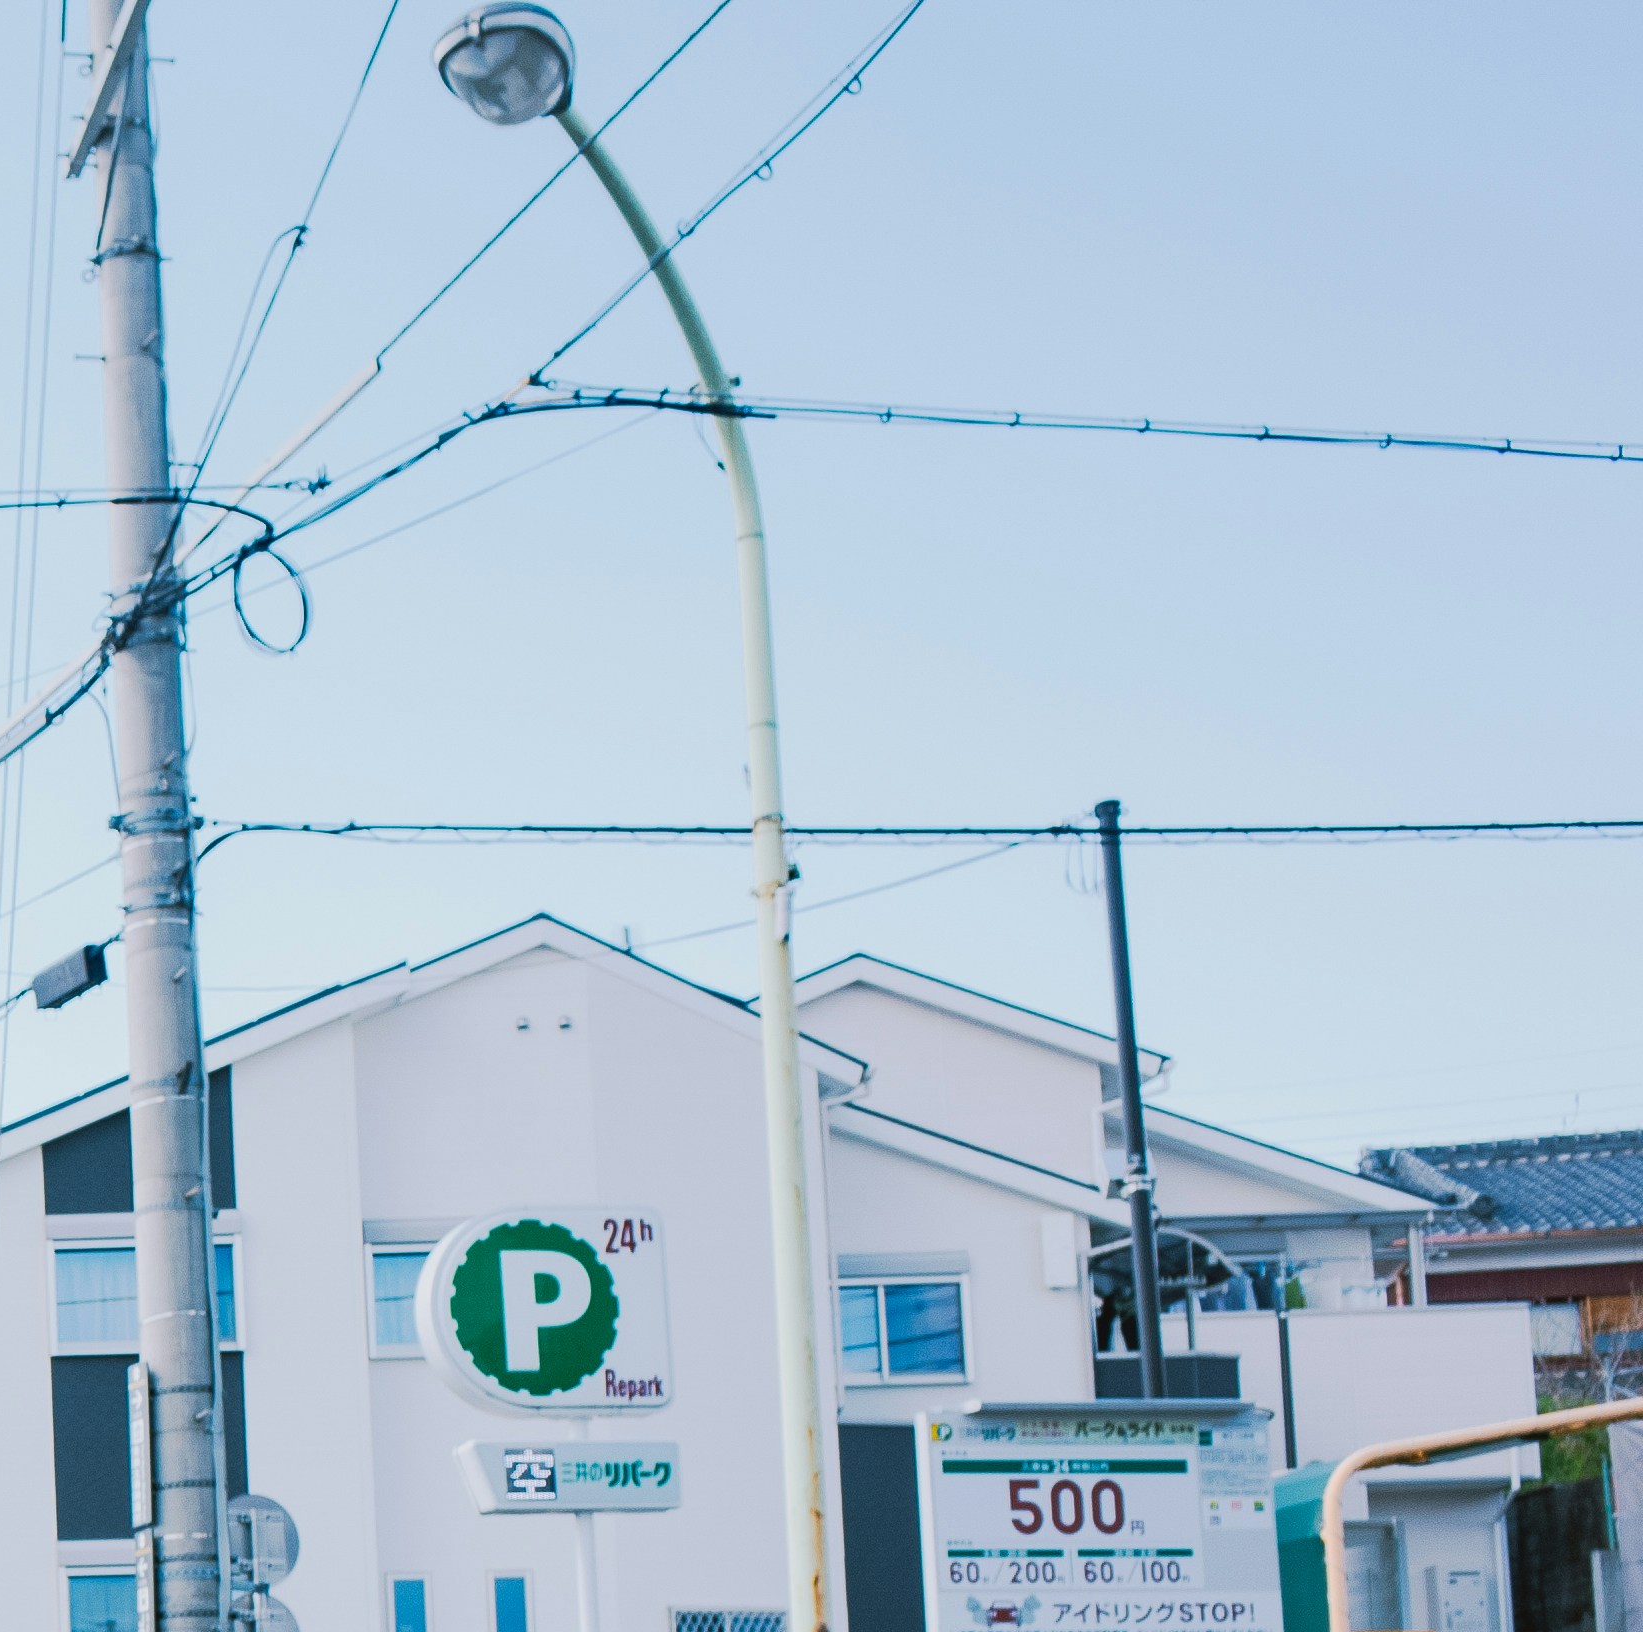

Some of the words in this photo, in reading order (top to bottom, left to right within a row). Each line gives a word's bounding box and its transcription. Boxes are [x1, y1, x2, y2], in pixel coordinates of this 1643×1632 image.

[603, 1218, 653, 1253] 24h
[499, 1249, 592, 1372] P
[604, 1368, 663, 1400] Repark
[505, 1449, 557, 1500] 空
[561, 1461, 672, 1488] 三井のリパーク
